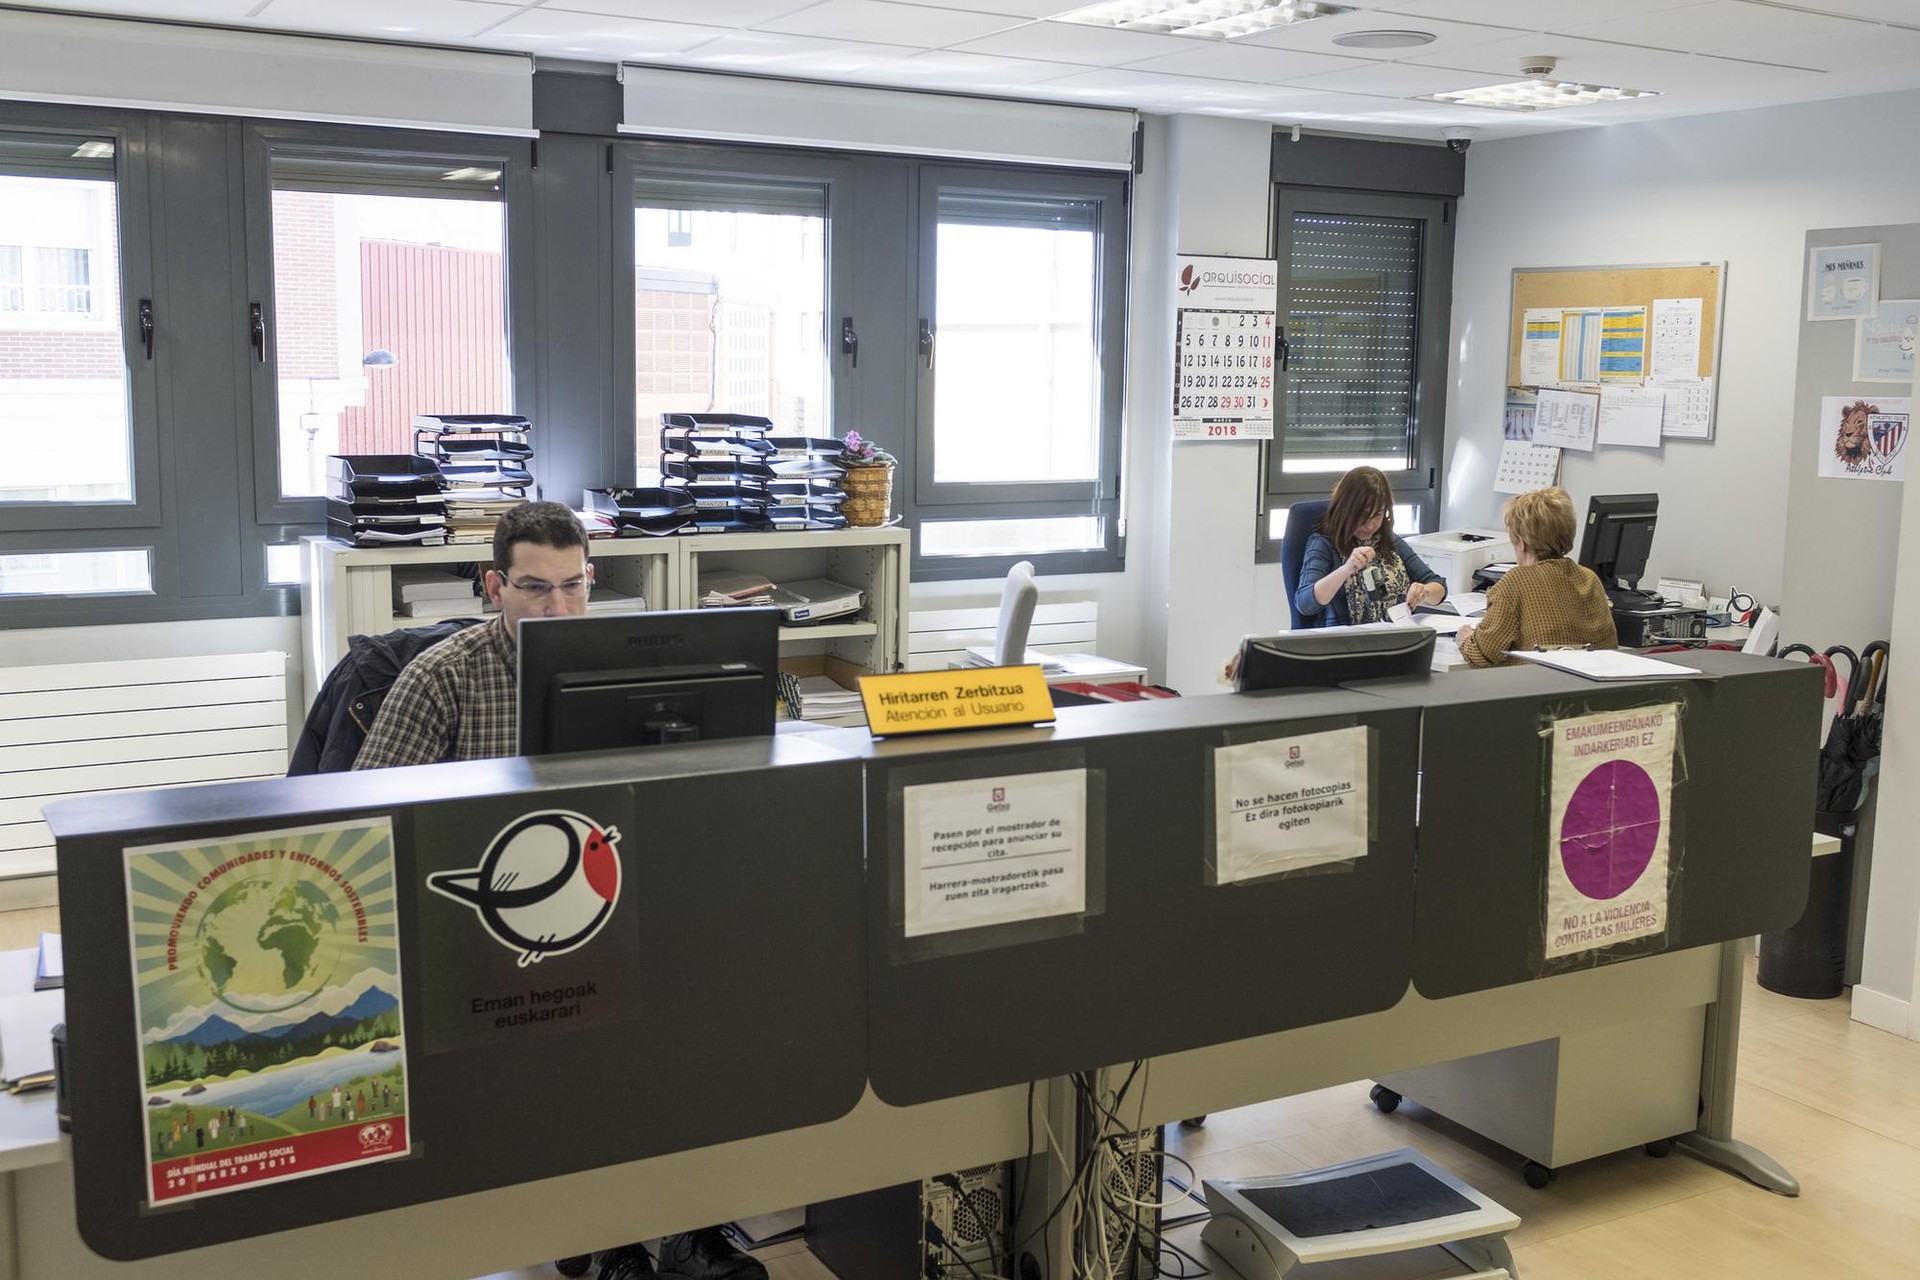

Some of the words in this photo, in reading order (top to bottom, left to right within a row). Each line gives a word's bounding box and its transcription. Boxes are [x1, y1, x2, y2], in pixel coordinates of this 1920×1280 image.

[1239, 315, 1245, 327] 2
[1252, 315, 1258, 327] 3
[1265, 316, 1271, 328] 4
[1186, 334, 1191, 346] 5
[1198, 334, 1204, 347] 6
[1212, 334, 1218, 347] 7
[1224, 335, 1231, 347] 8
[1238, 335, 1244, 347] 9
[1249, 335, 1259, 348] 10
[1262, 336, 1271, 348] 11
[1183, 354, 1193, 367] 12
[1197, 355, 1207, 367] 13
[1210, 355, 1220, 367] 14
[1223, 355, 1233, 368] 15
[1236, 355, 1245, 368] 16
[1249, 355, 1258, 368] 17
[1262, 356, 1272, 368] 18
[1183, 375, 1193, 388] 19
[1195, 375, 1206, 388] 20
[1209, 375, 1218, 388] 21
[1221, 376, 1232, 388] 22
[1234, 376, 1245, 388] 23
[1247, 376, 1258, 388] 24
[1260, 376, 1271, 388] 25
[1181, 395, 1192, 408] 26
[1194, 396, 1205, 408] 27
[1207, 396, 1218, 408] 28
[1221, 396, 1231, 408] 29
[1234, 396, 1244, 408] 30
[1247, 396, 1256, 408] 31
[1208, 426, 1237, 436] 2018
[879, 688, 949, 706] Hiritarren
[955, 683, 1024, 700] Zerbitzua
[886, 705, 946, 722] Atención
[954, 705, 965, 717] al
[971, 701, 1025, 715] Usuario
[1566, 713, 1663, 741] EMAKUMEENGANAKO
[1573, 734, 1639, 757] INDARKERIARI
[1642, 732, 1655, 745] EZ
[1236, 798, 1250, 809] No
[1252, 797, 1265, 806] se
[1267, 791, 1299, 804] hacen
[1301, 781, 1351, 798] fotocopias
[1245, 812, 1257, 822] Ez
[1259, 808, 1280, 820] dira
[1282, 797, 1344, 815] fotokopiarik
[933, 829, 963, 840] Pasen
[966, 827, 982, 838] por
[985, 825, 994, 834] el
[997, 819, 1046, 833] mostrador
[1048, 818, 1061, 828] de
[1278, 816, 1311, 830] egiten
[931, 837, 980, 854] recepción
[982, 837, 1004, 848] para
[1007, 830, 1048, 844] anunciar
[1051, 830, 1062, 839] su
[987, 848, 1008, 858] cita.
[929, 868, 1039, 891] Harrera-mostradoretik
[1042, 865, 1064, 878] pasa
[945, 891, 968, 901] zuen
[971, 887, 989, 898] zita
[992, 880, 1049, 895] iragartzeko.
[167, 890, 198, 971] PROMOVIENDO
[197, 850, 275, 890] COMUNIDADES
[279, 850, 287, 859] Y
[289, 851, 342, 882] ENTORNOS
[340, 880, 368, 943] SOSTENIBLES
[1563, 914, 1579, 930] NO
[1580, 912, 1588, 927] A
[1589, 909, 1602, 925] LA
[1603, 900, 1651, 921] VIOLENCIA
[1554, 927, 1593, 948] CONTRA
[1595, 922, 1613, 938] LAS
[1614, 913, 1657, 935] MUJERES
[471, 994, 524, 1014] Eman
[530, 980, 599, 1004] hegoak
[495, 1001, 581, 1029] euskarari
[167, 1177, 186, 1189] 20
[197, 1165, 248, 1183] MARZO
[259, 1155, 296, 1170] 2018
[182, 1162, 218, 1175] MUNDIAL
[219, 1158, 233, 1168] DEL
[234, 1151, 268, 1165] TRABAJO
[268, 1146, 295, 1158] SOCIAL
